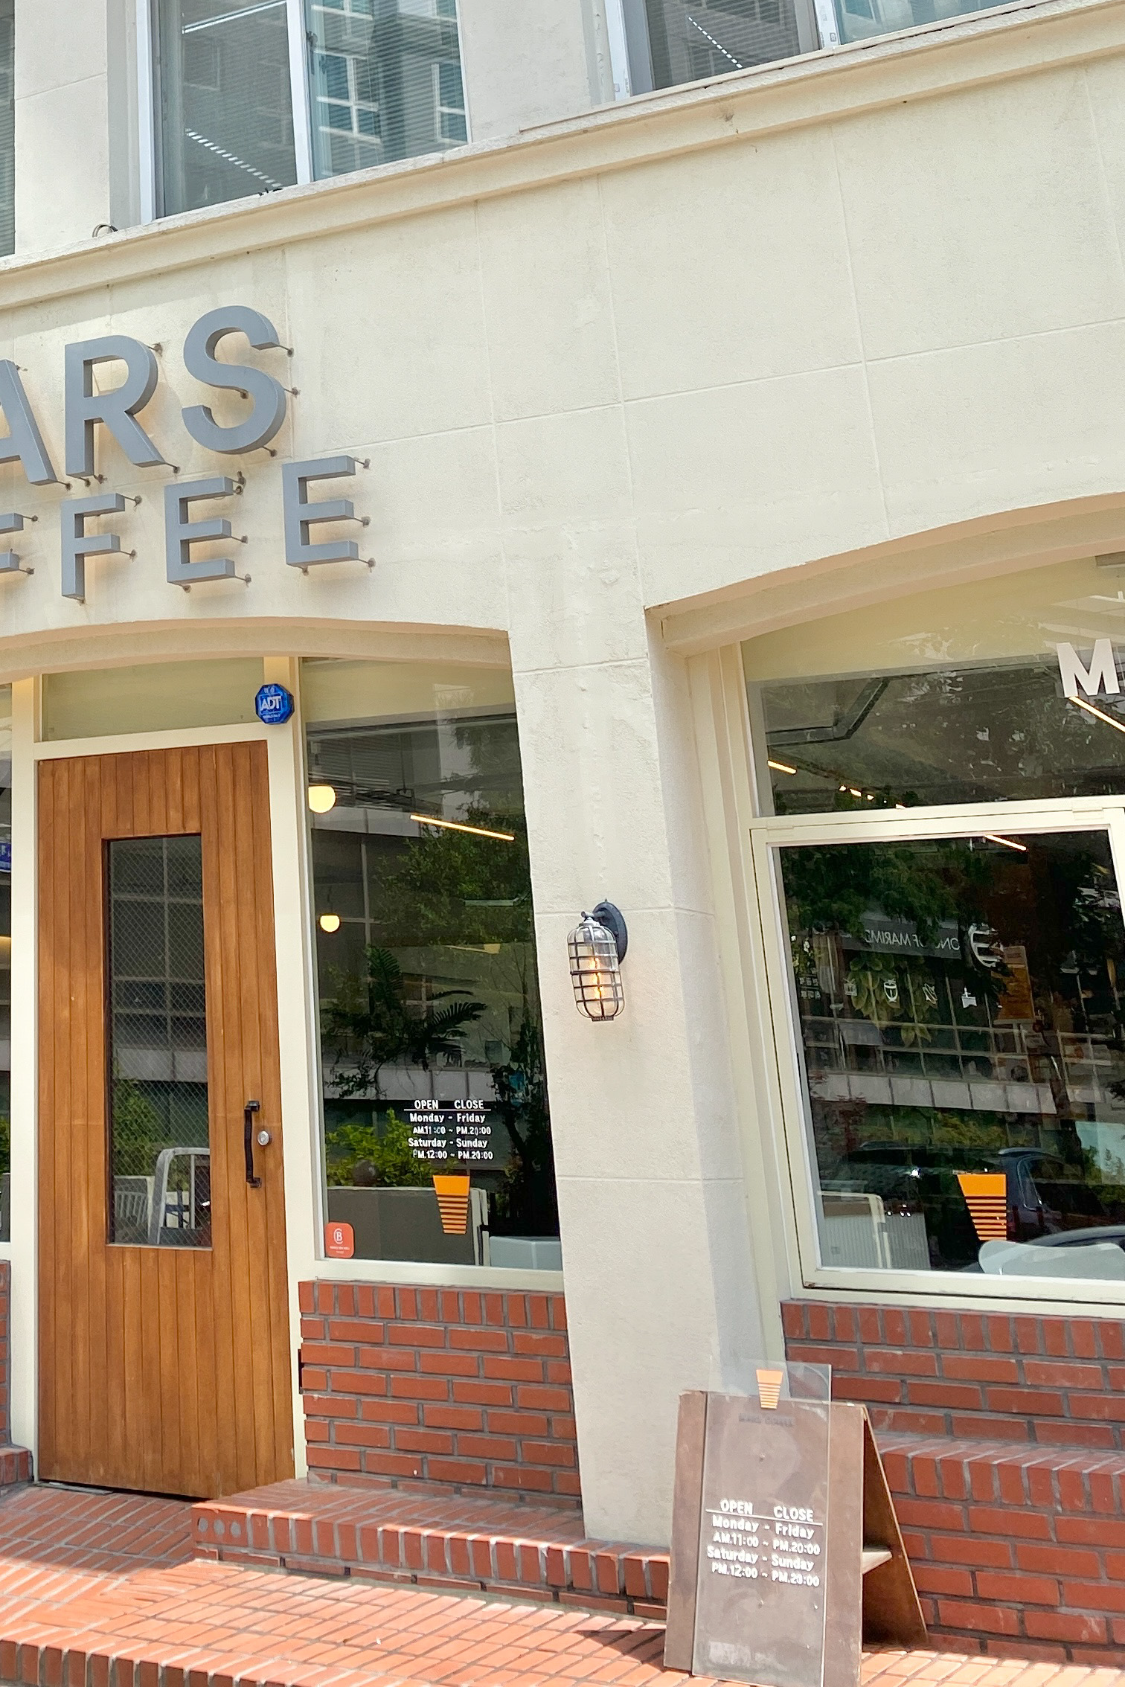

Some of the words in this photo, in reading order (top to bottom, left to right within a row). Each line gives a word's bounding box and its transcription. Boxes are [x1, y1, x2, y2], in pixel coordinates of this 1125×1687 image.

[260, 696, 282, 710] ADT
[415, 1100, 439, 1109] OPEN
[454, 1100, 484, 1109] CLOSE
[409, 1113, 445, 1123] Monday
[456, 1113, 485, 1123] Friday
[408, 1138, 446, 1148] Saturday
[456, 1138, 487, 1148] Sunday
[458, 1150, 493, 1159] PM.20:00
[720, 1499, 753, 1515] OPEN
[773, 1505, 814, 1522] CLOSE
[712, 1514, 759, 1532] Monday
[775, 1522, 815, 1540] Friday
[713, 1531, 759, 1548] AM.11:00
[772, 1538, 821, 1556] PM.20:00
[706, 1545, 759, 1565] Saturday
[771, 1553, 815, 1572] Sunday
[711, 1562, 759, 1579] PM.12:00
[771, 1569, 820, 1587] PM.20:00
